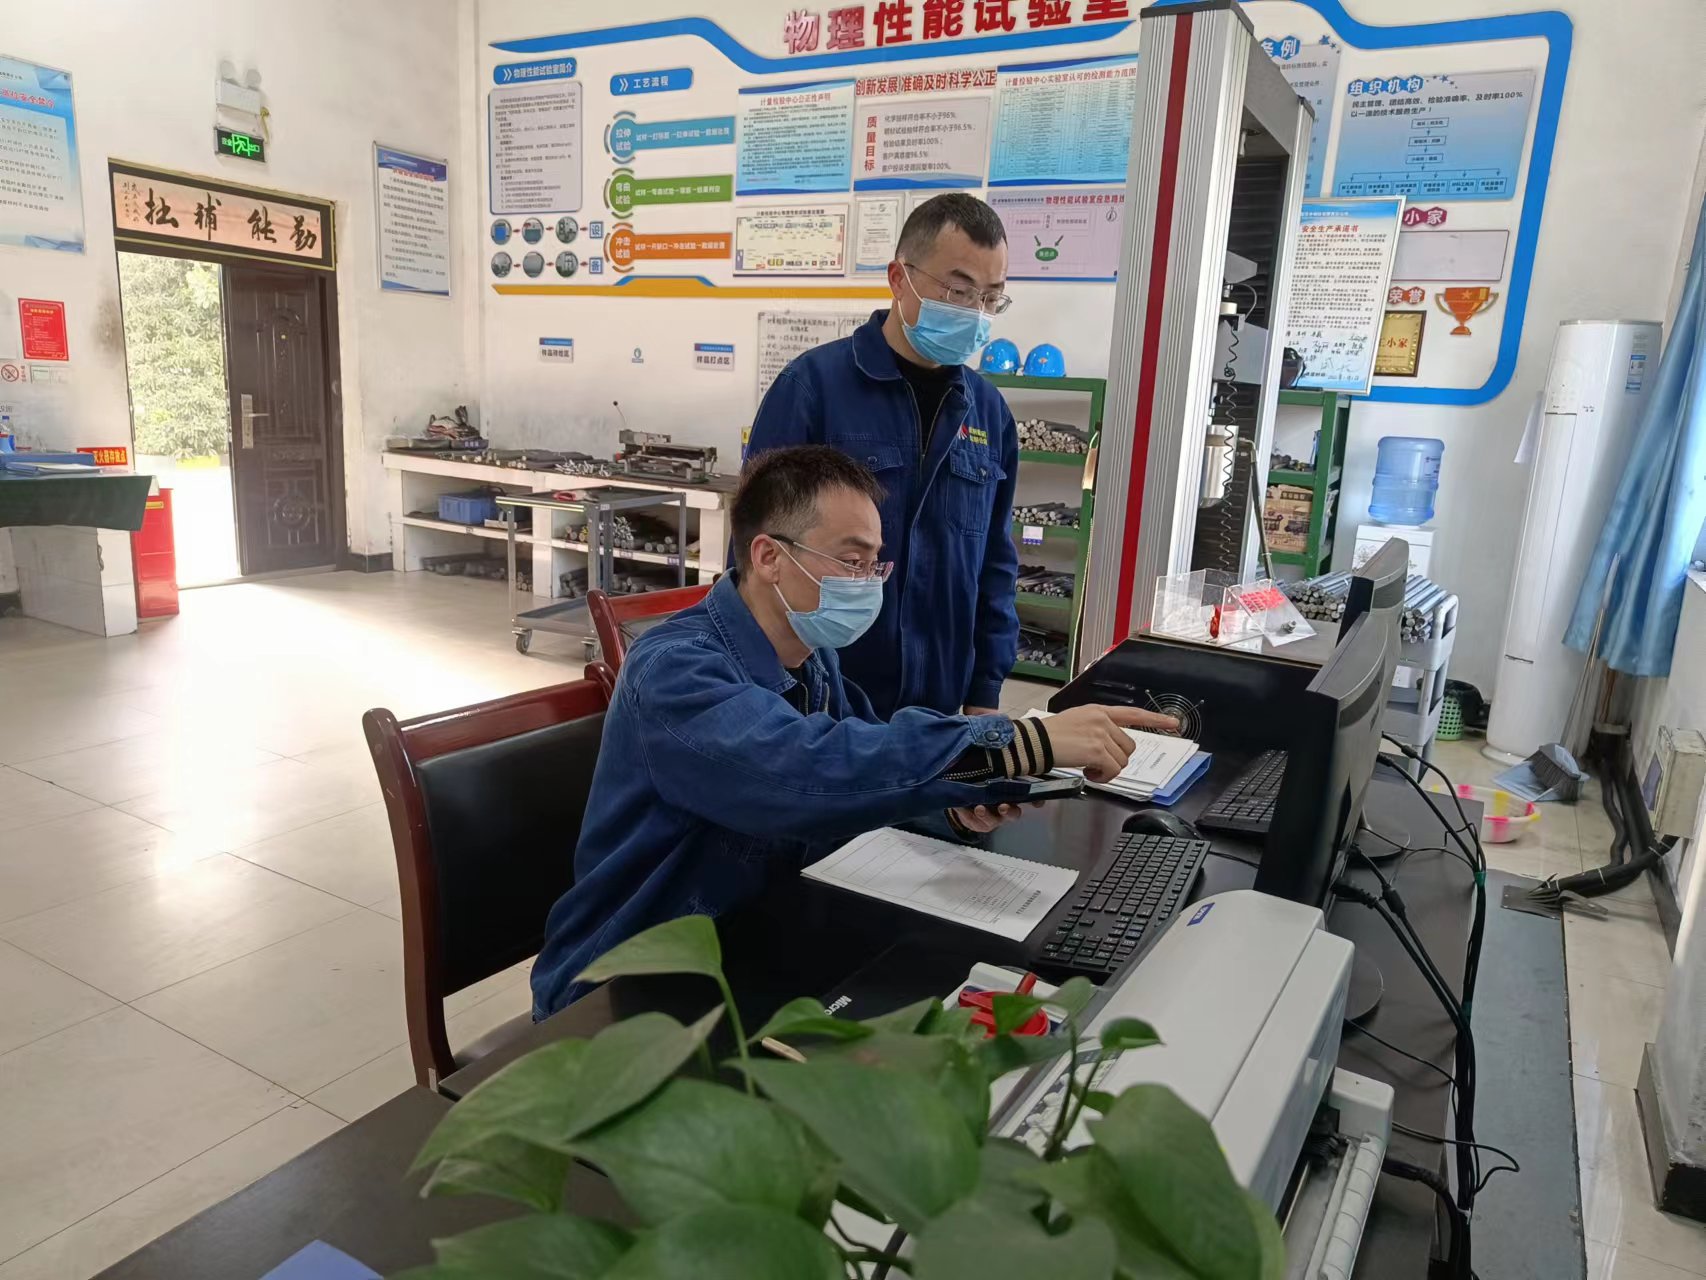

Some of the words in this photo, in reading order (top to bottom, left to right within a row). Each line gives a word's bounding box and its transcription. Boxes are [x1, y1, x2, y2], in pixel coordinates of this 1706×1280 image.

[633, 76, 669, 89] 工艺流程
[855, 76, 898, 96] 创新发展
[901, 72, 947, 93] 准确及时
[949, 68, 997, 89] 科学公正
[1350, 77, 1422, 95] 组织机构
[616, 128, 631, 138] 拉伸
[616, 141, 631, 150] 试验
[864, 115, 878, 171] 质量目标
[616, 195, 630, 204] 试验
[1404, 210, 1444, 224] 小家
[616, 249, 630, 258] 试验
[1389, 288, 1423, 304] 荣誉
